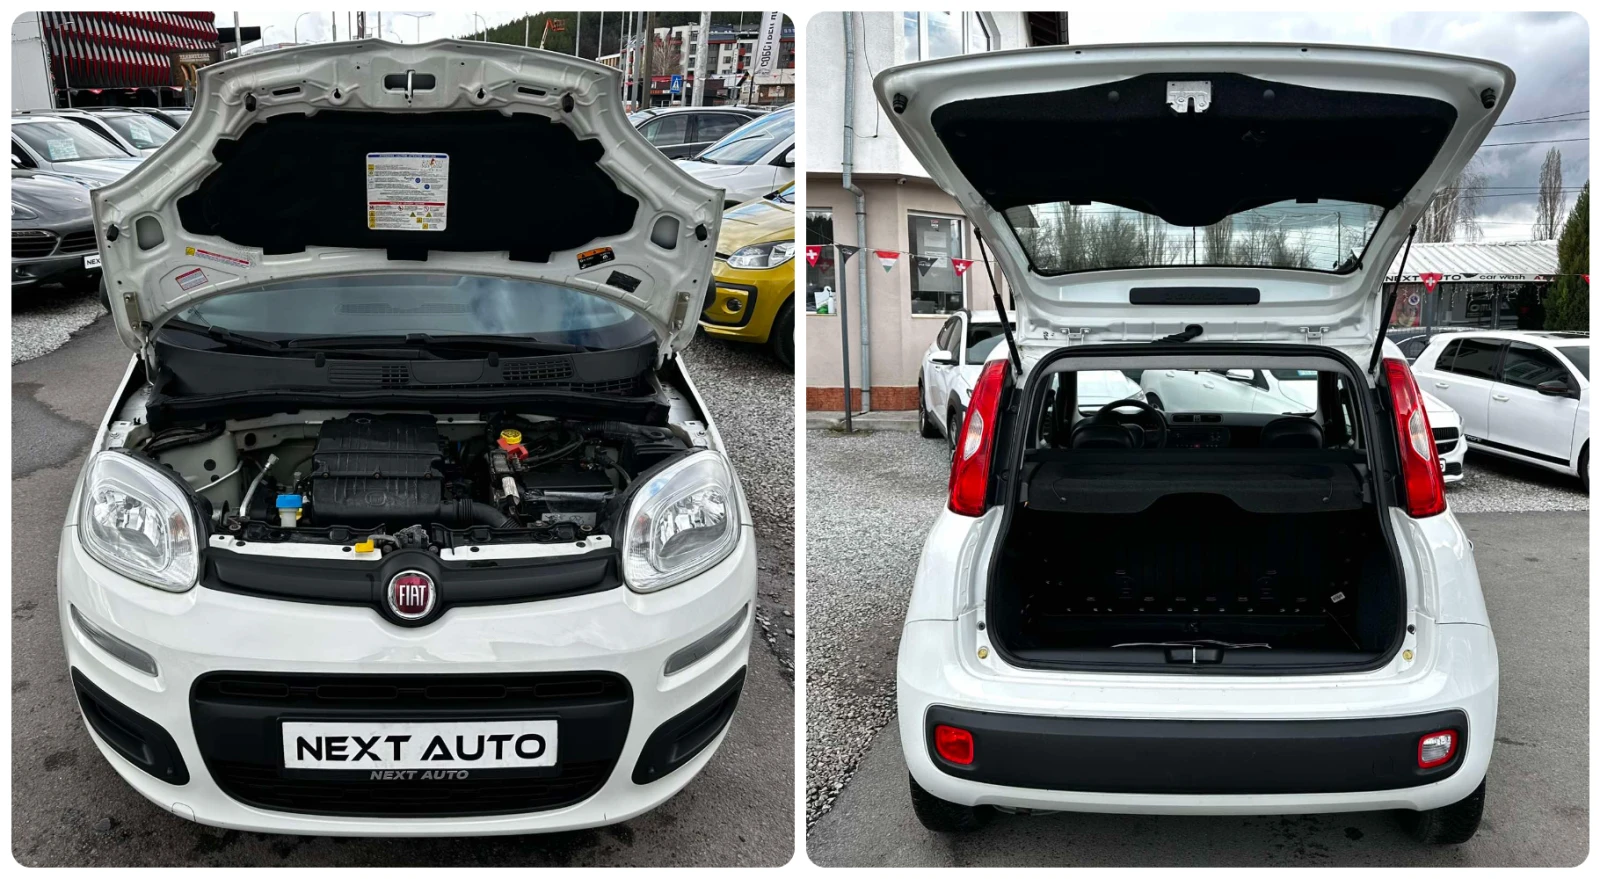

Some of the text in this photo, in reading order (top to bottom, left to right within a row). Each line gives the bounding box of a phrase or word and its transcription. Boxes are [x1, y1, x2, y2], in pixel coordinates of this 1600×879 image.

[399, 585, 426, 606] FIAT
[296, 733, 547, 761] NEXT AUTO
[370, 770, 470, 780] NEXT AUTO
